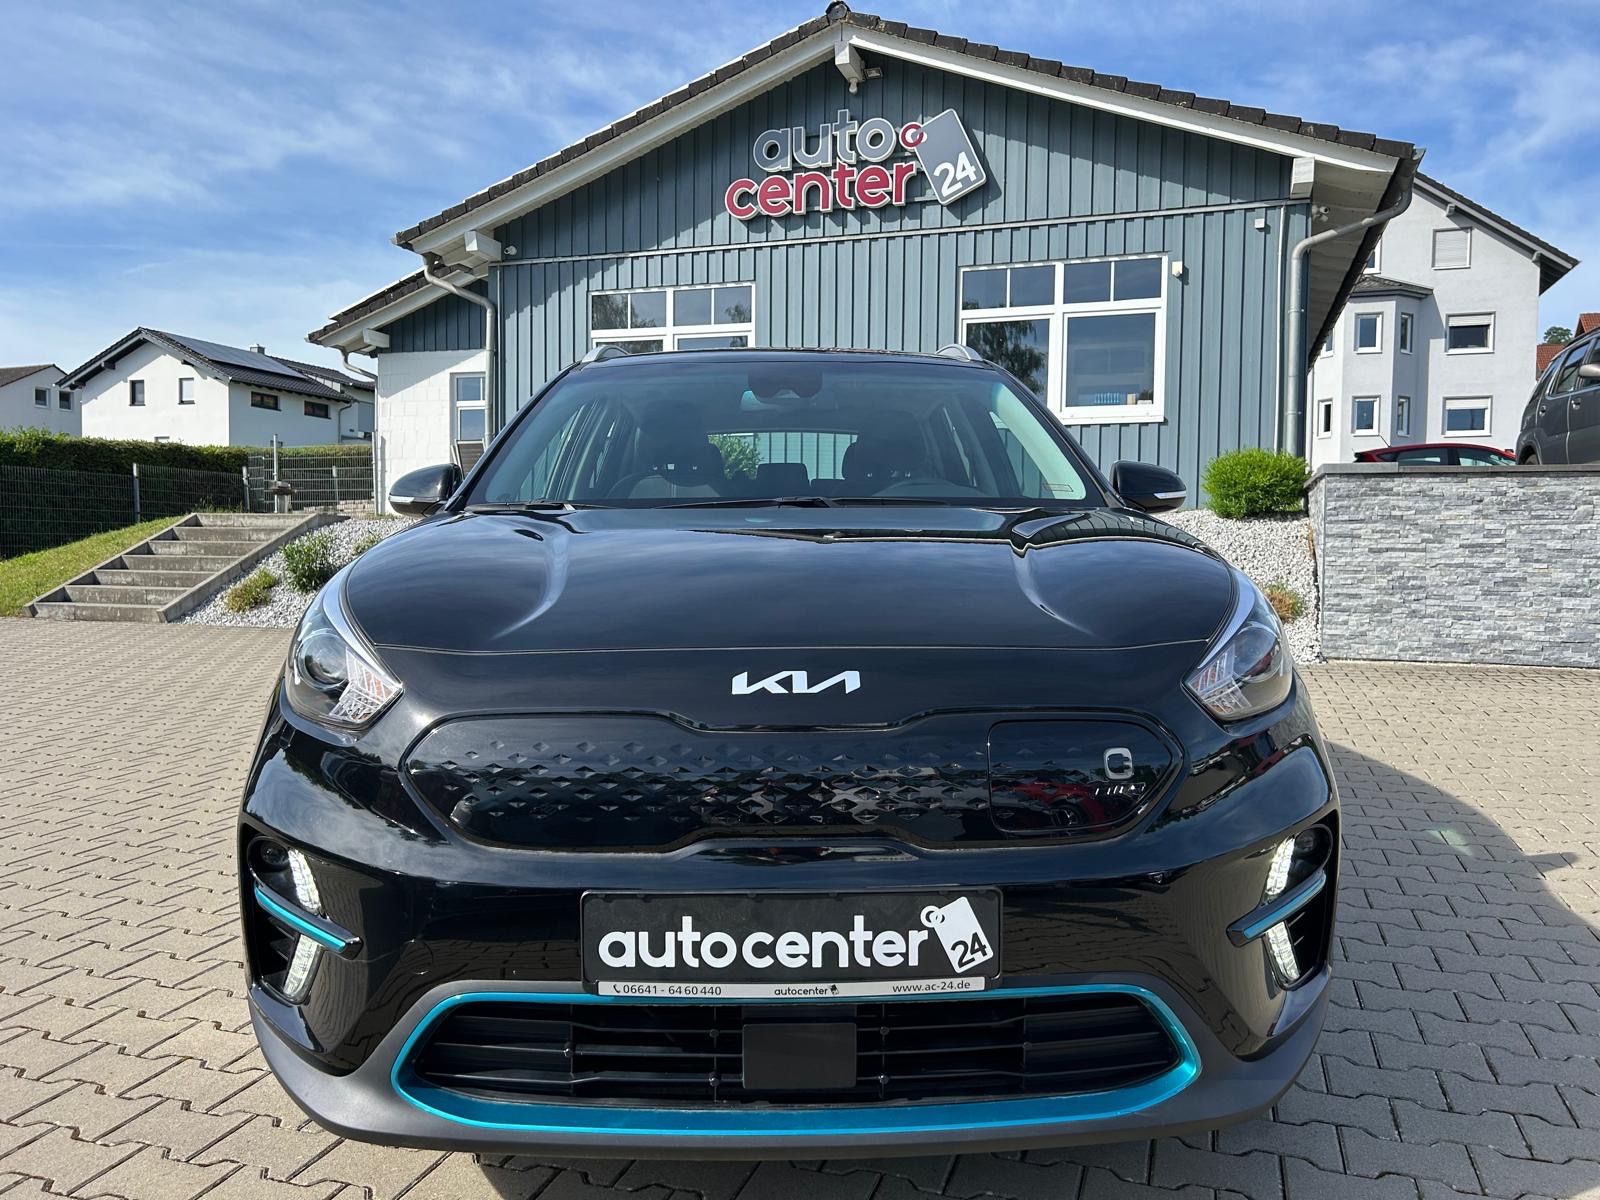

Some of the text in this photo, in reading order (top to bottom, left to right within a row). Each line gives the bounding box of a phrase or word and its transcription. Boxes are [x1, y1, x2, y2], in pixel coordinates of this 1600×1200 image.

[753, 109, 896, 172] auto
[725, 161, 916, 220] center
[932, 151, 977, 198] 24
[950, 931, 988, 969] 24
[623, 984, 657, 994] 06641
[774, 986, 828, 996] autocenter
[892, 981, 971, 993] www.ac-24.de
